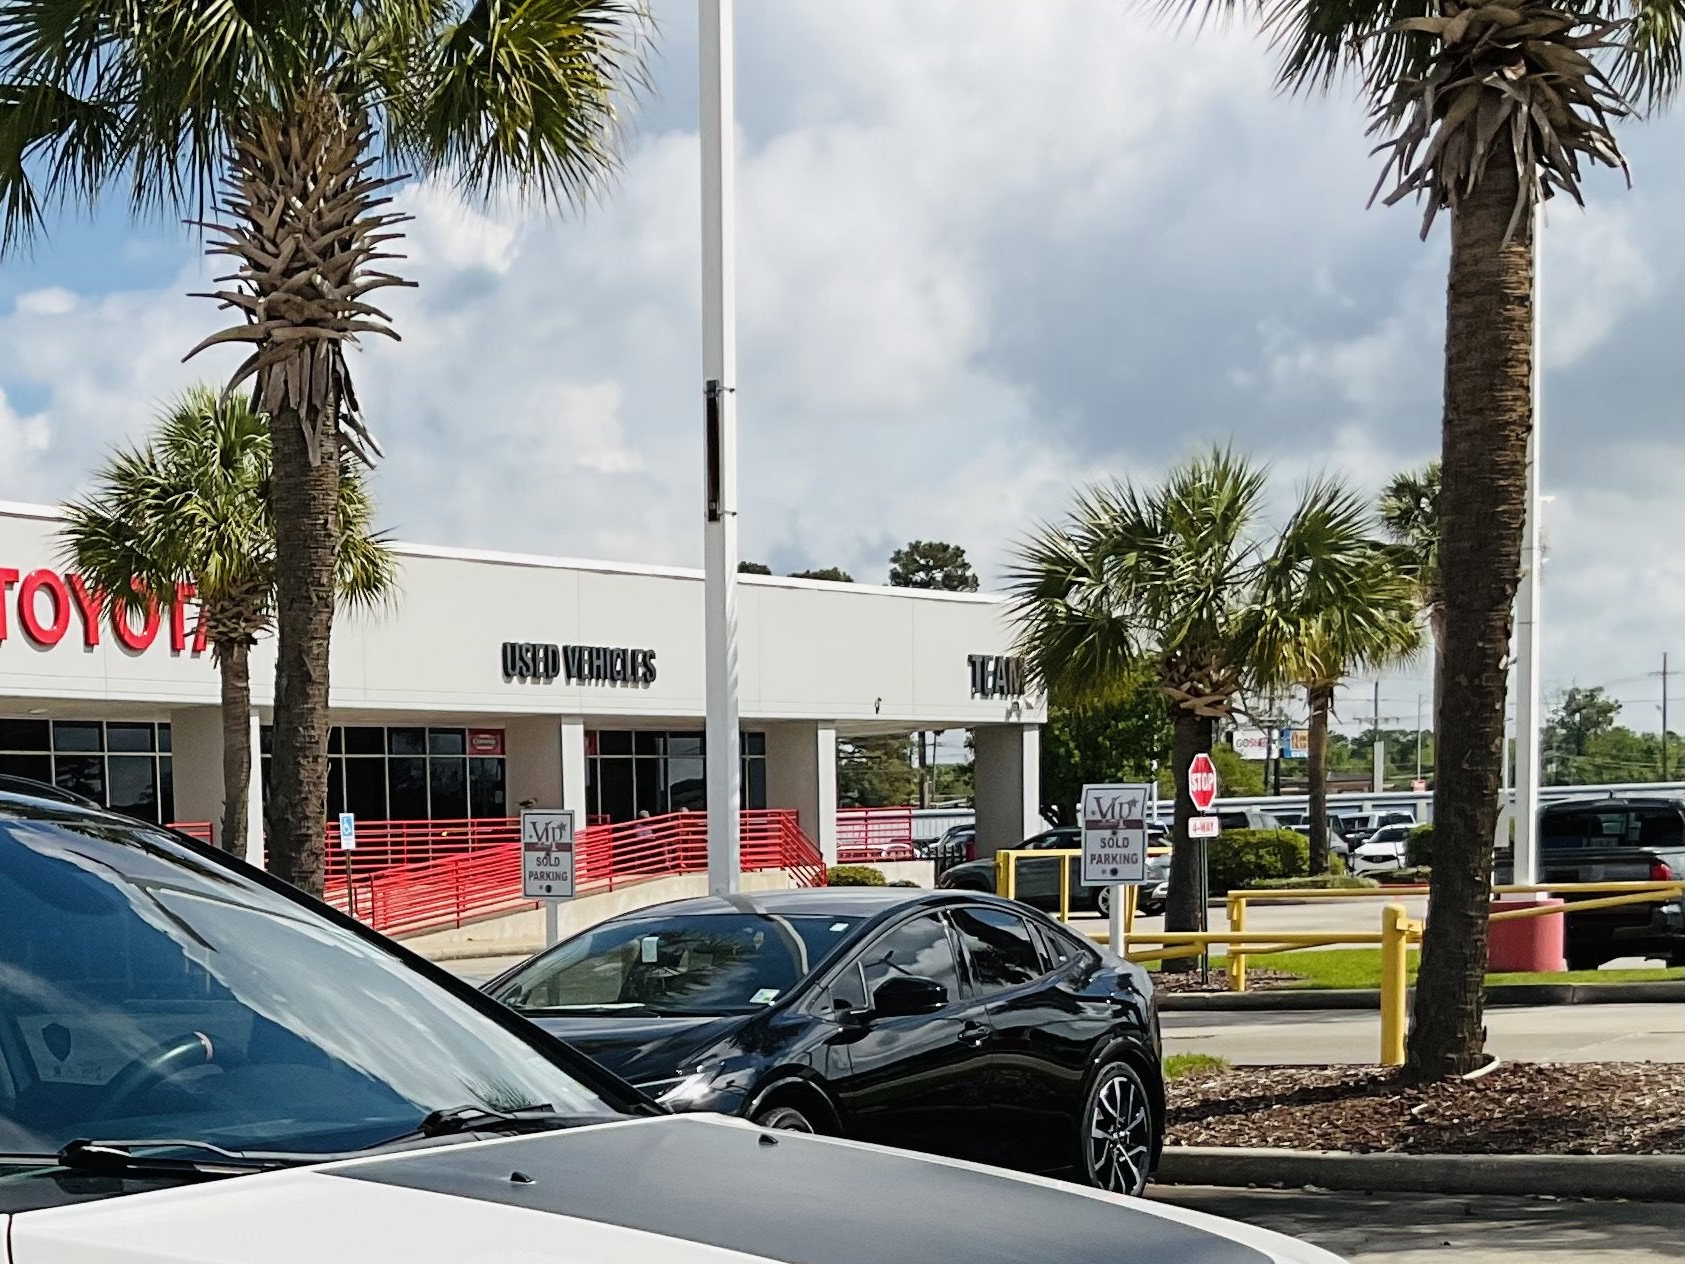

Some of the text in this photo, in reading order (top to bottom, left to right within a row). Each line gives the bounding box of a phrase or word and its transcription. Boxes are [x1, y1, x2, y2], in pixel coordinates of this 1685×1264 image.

[502, 642, 656, 683] USED VEHICLES
[1191, 772, 1214, 792] STOP
[1099, 837, 1130, 848] SOLD
[536, 856, 561, 867] SOLD
[1090, 853, 1139, 865] PARKING
[528, 871, 568, 881] PARKING
